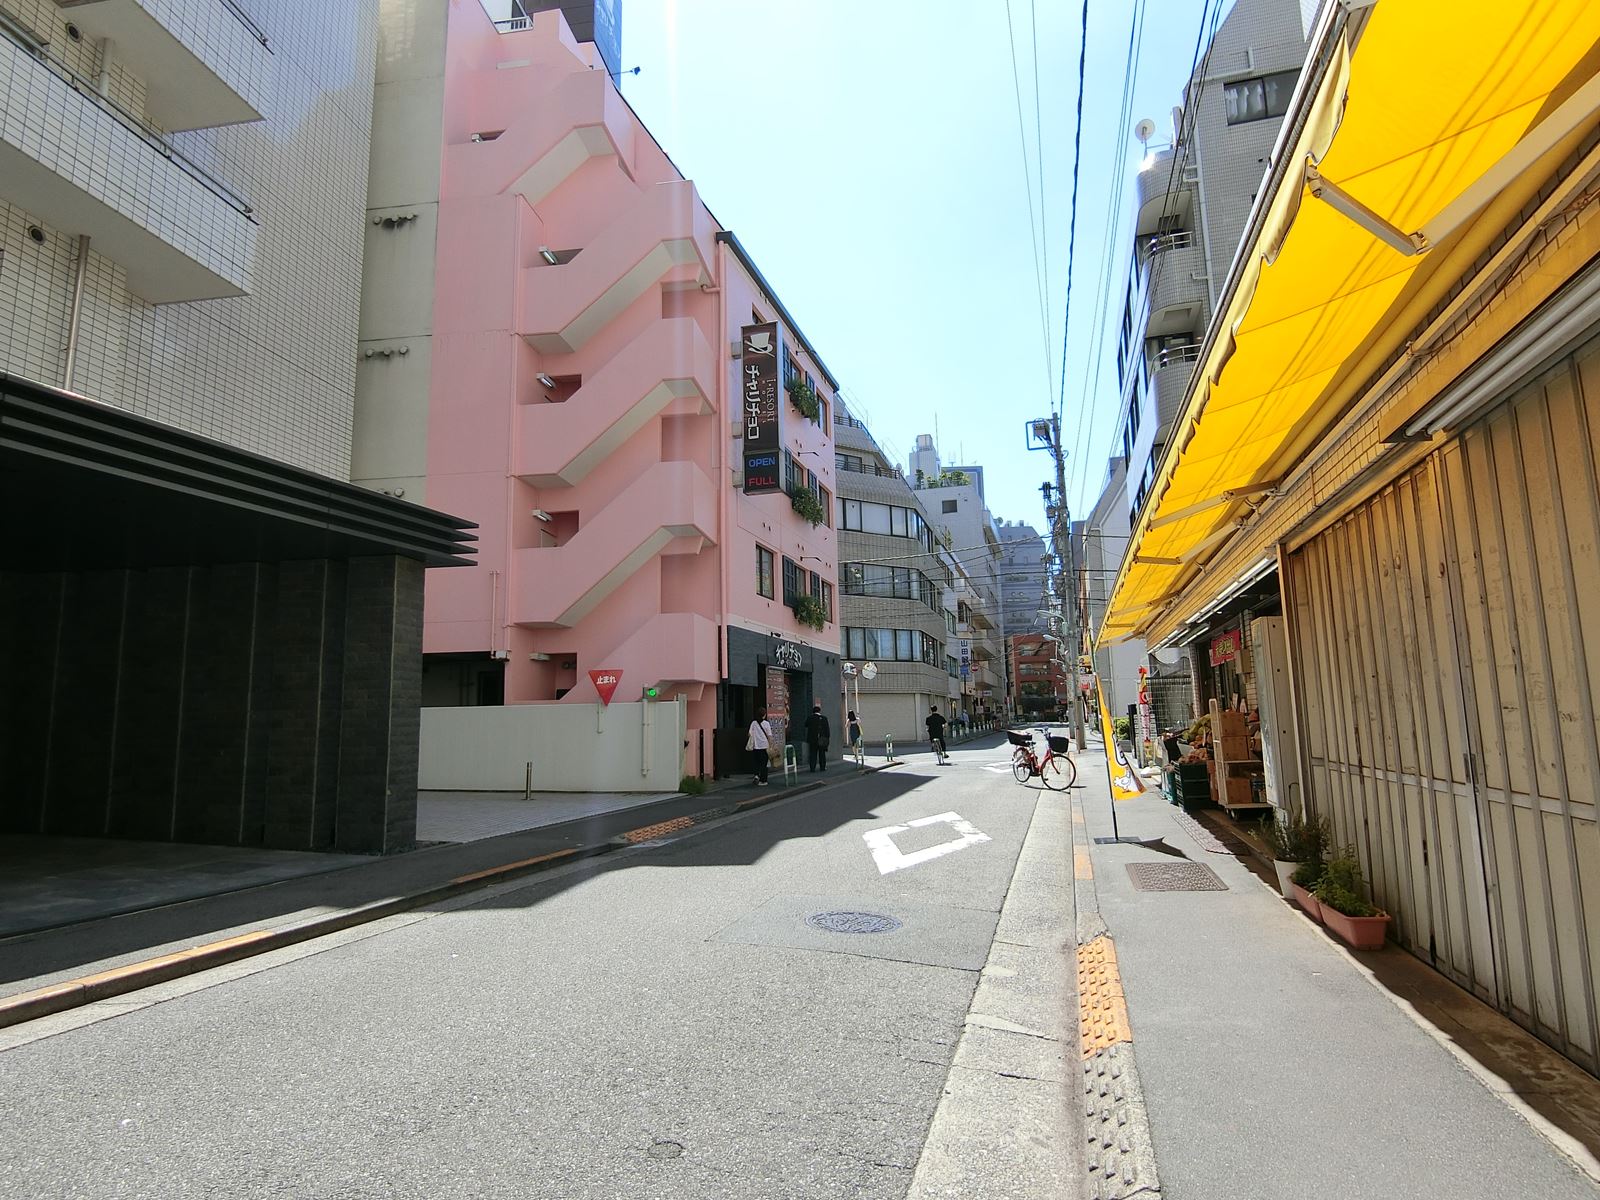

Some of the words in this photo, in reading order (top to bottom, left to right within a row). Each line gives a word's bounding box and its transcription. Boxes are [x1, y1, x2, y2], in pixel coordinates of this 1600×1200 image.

[748, 457, 776, 468] OPEN
[748, 476, 776, 487] FULL
[596, 675, 616, 684] 止まれ
